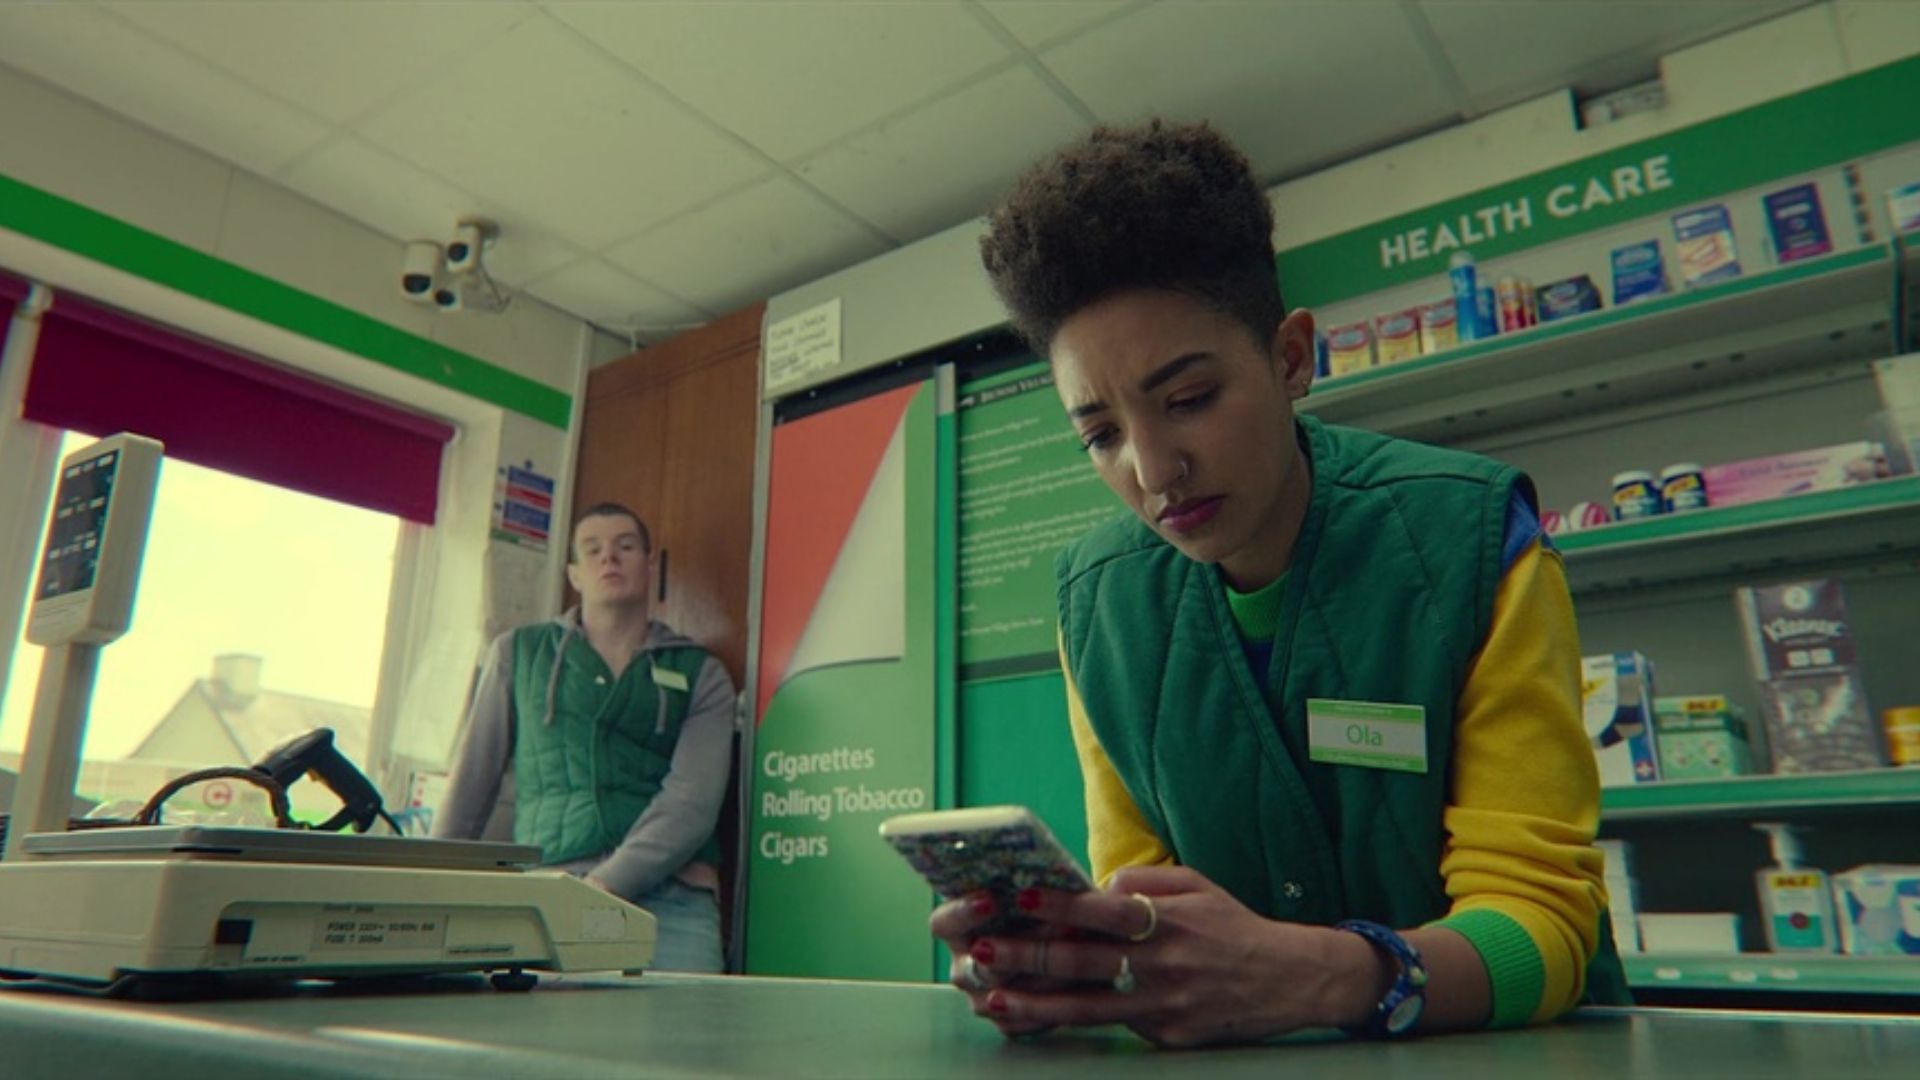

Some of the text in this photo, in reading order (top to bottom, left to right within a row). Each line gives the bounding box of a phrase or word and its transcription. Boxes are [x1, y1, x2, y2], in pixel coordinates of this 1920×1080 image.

[1379, 155, 1674, 269] HEALTH CARE
[1346, 723, 1383, 747] Ola
[763, 747, 875, 782] Cigarettes
[762, 784, 924, 821] Rolling Tobacco
[760, 832, 828, 865] Cigars
